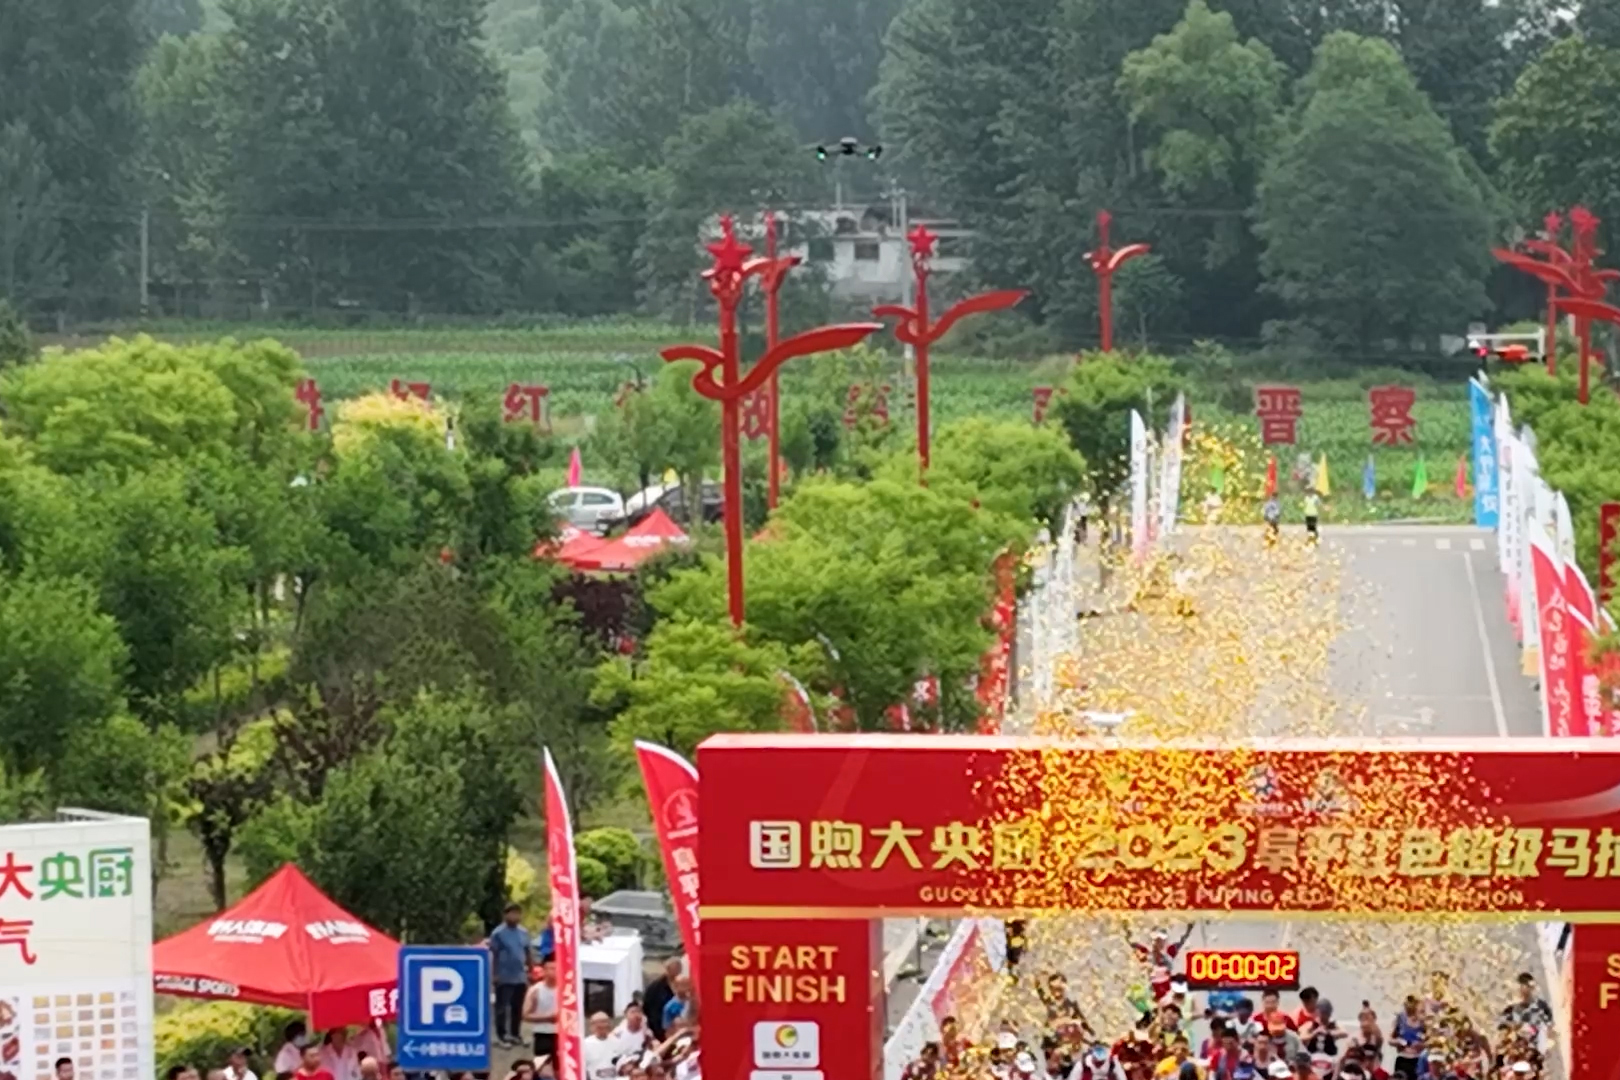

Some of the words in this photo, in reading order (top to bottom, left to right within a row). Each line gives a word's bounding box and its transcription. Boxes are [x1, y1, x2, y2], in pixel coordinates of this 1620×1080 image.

[1256, 387, 1417, 445] 晋察
[730, 946, 838, 970] START
[1191, 953, 1297, 981] 00:00:02
[421, 966, 465, 1025] P
[723, 975, 846, 1003] FINISH
